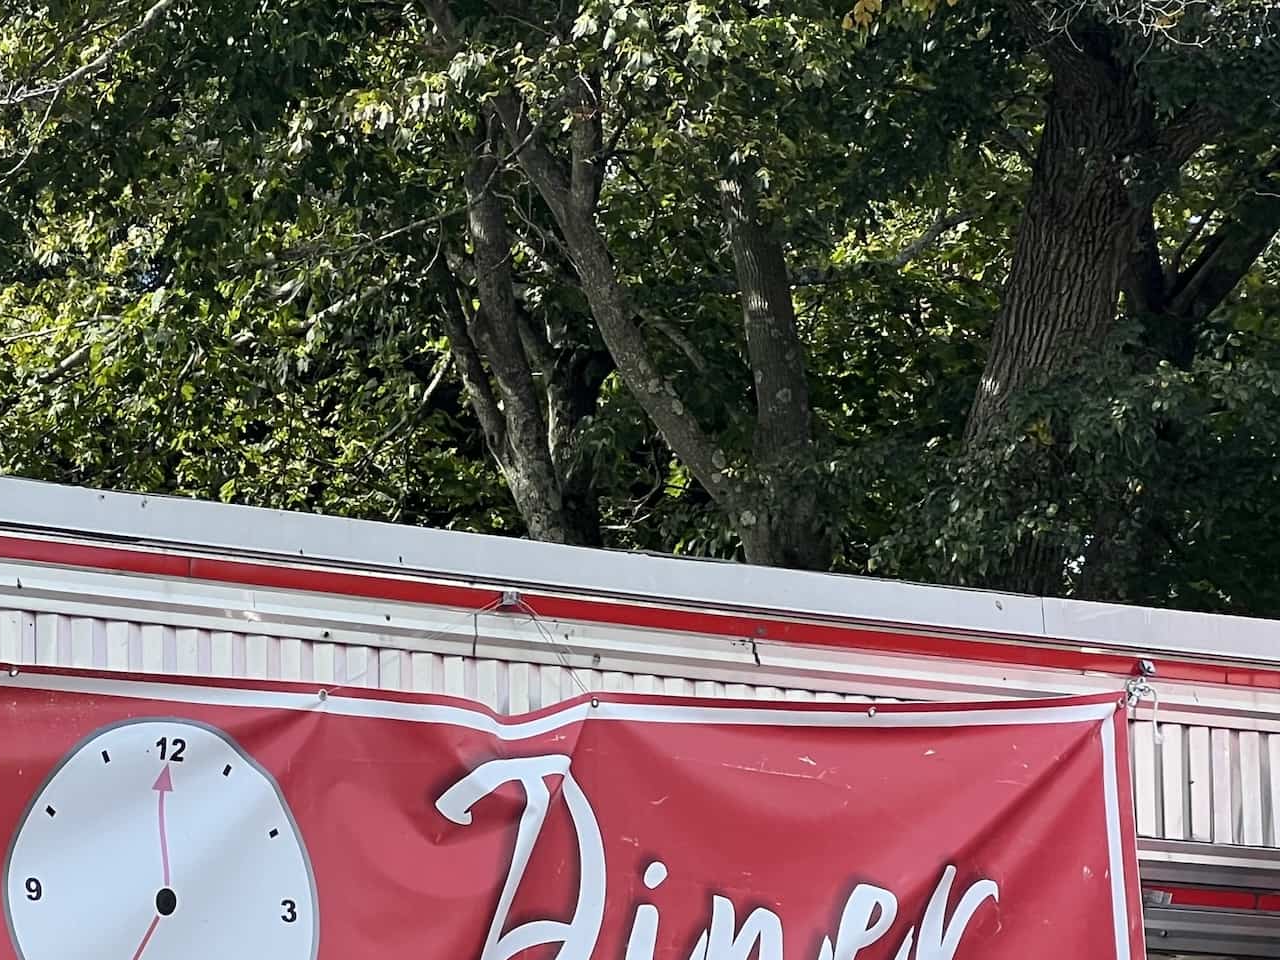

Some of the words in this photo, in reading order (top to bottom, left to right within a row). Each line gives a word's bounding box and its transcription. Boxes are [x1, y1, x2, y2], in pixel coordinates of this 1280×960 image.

[155, 737, 187, 762] 12
[24, 877, 43, 901] 9
[280, 899, 298, 923] 3
